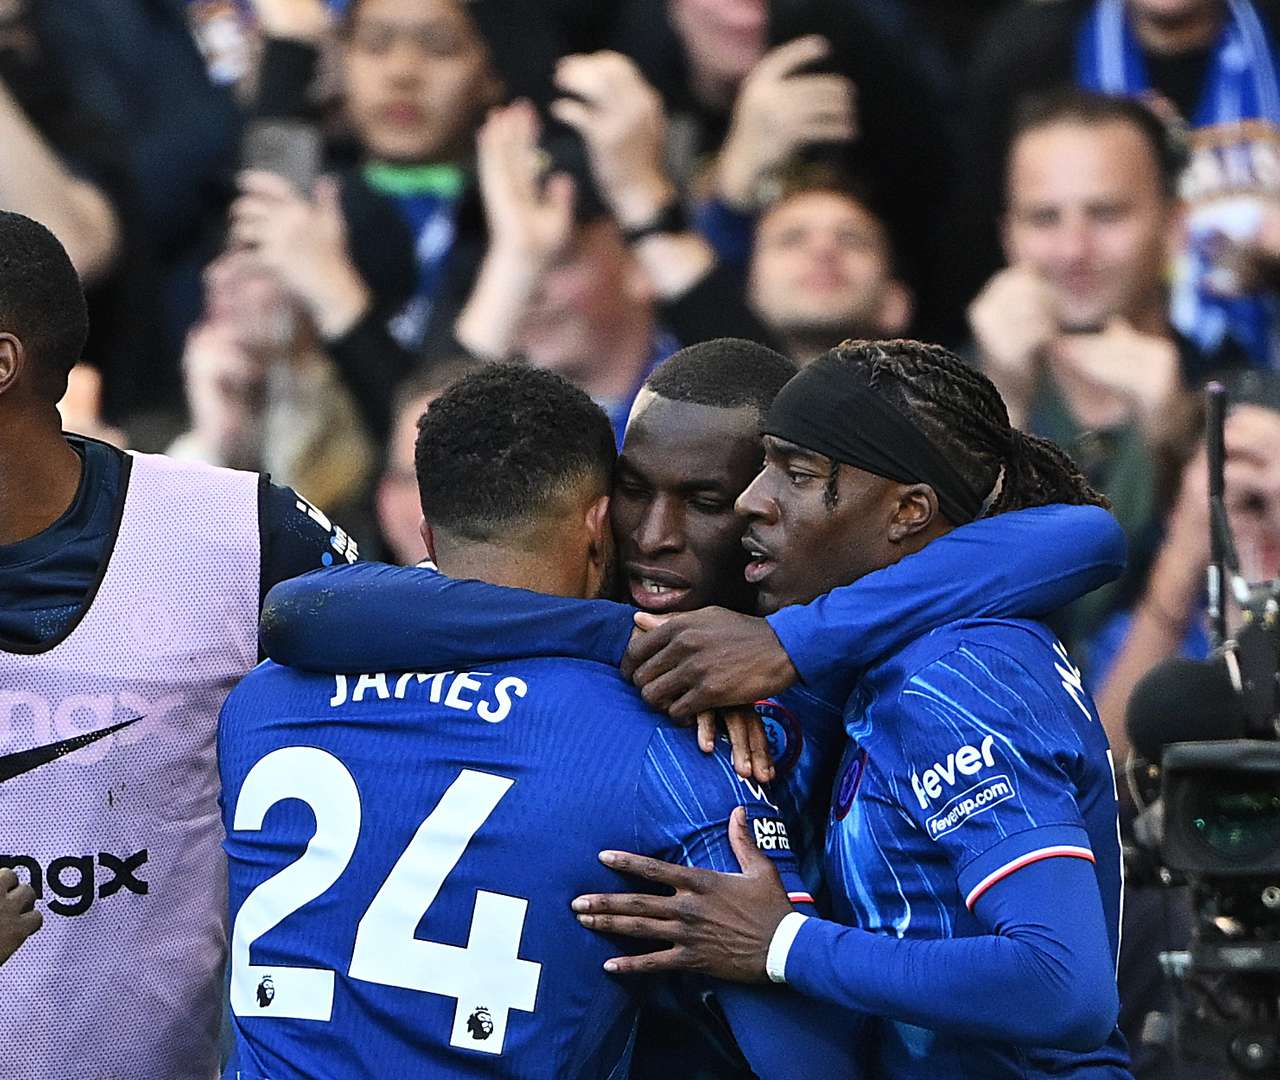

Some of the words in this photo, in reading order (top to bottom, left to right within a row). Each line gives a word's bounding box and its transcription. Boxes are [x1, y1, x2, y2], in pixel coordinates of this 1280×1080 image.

[330, 670, 528, 723] JAMES
[911, 735, 995, 810] fever
[753, 817, 776, 835] No
[931, 782, 1009, 834] feverup.com
[230, 745, 542, 1055] 24
